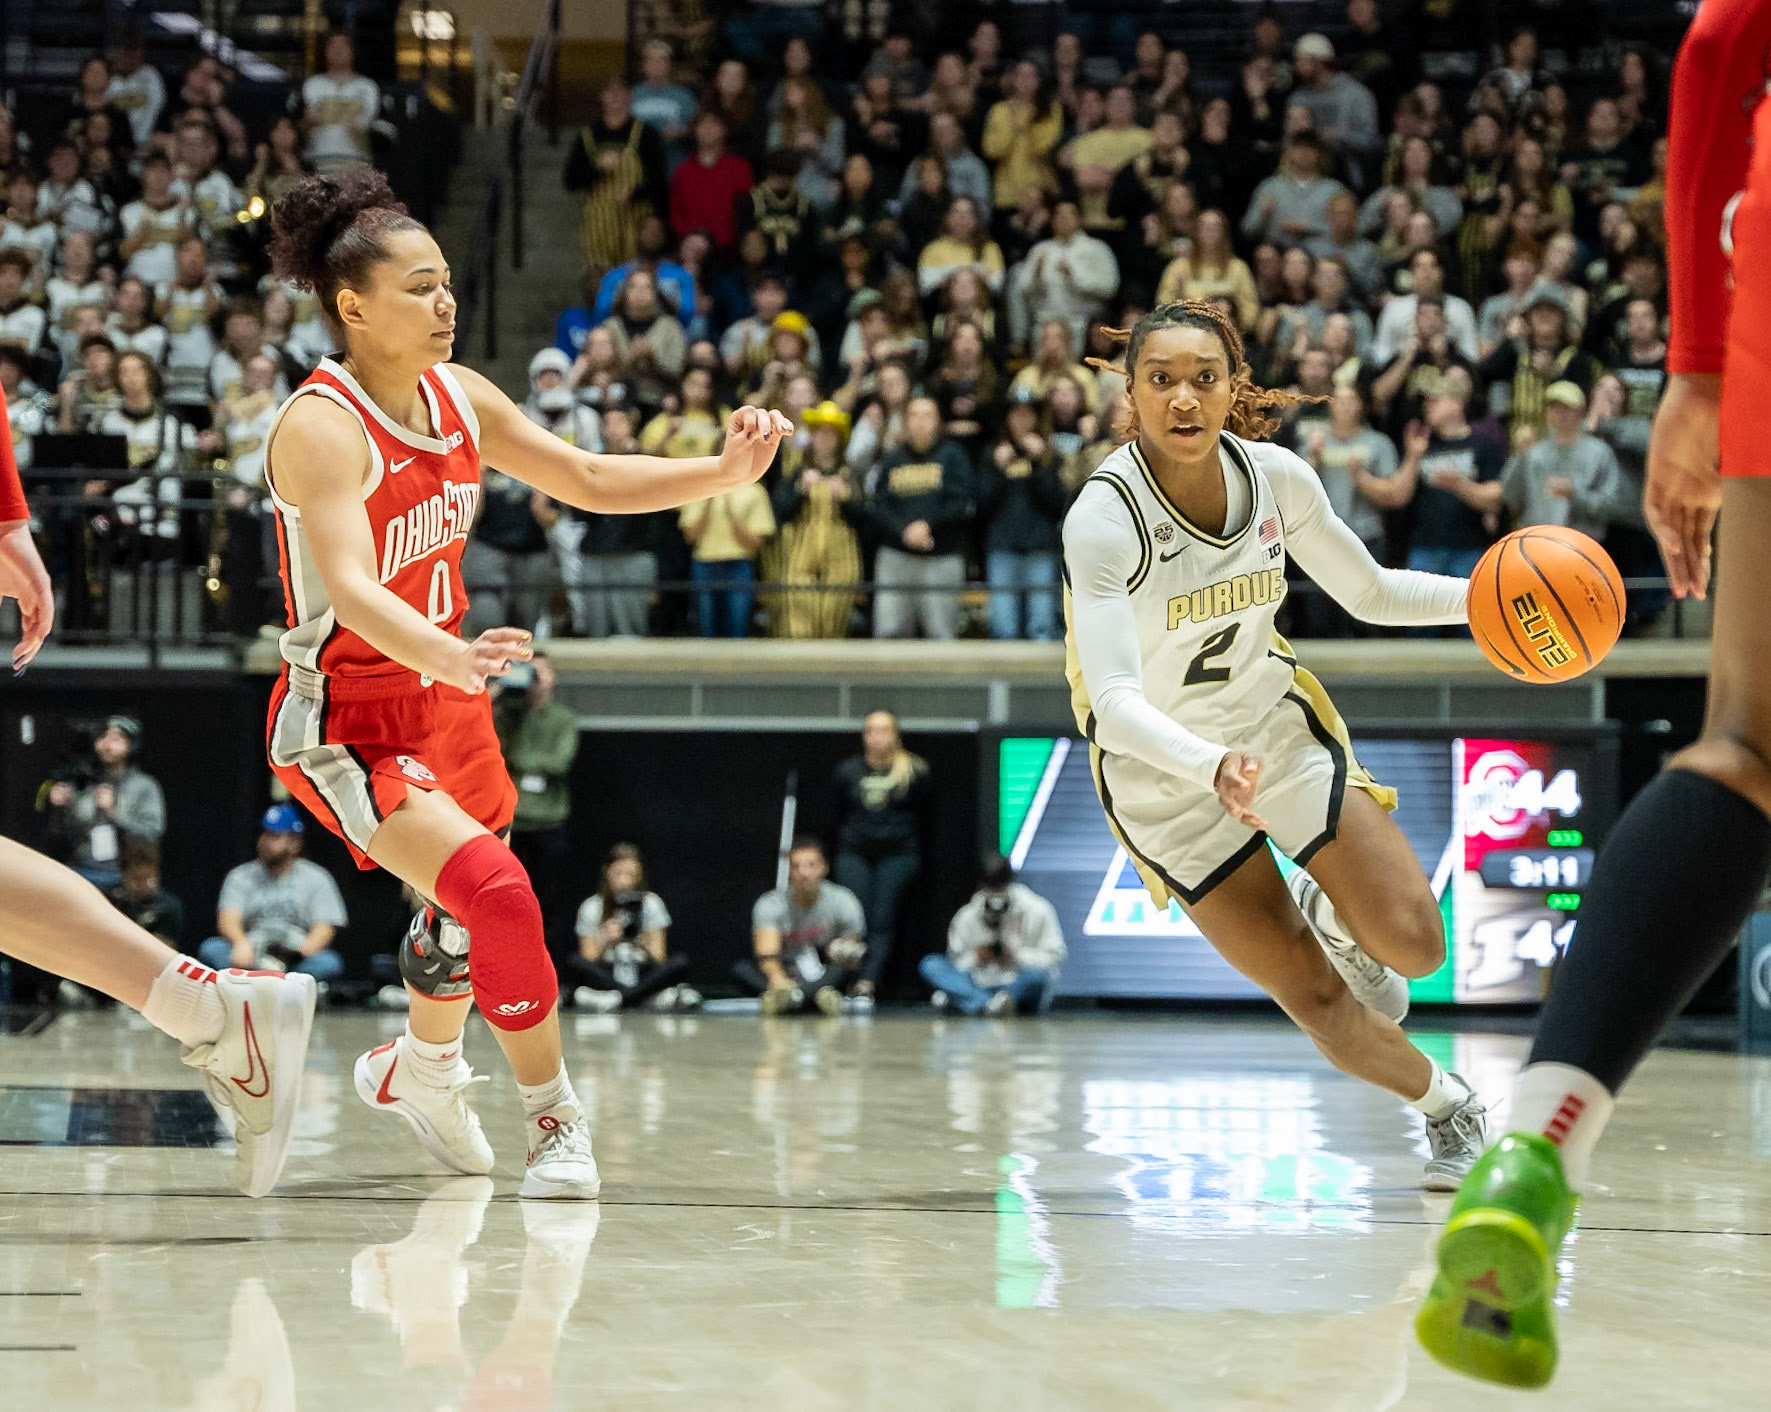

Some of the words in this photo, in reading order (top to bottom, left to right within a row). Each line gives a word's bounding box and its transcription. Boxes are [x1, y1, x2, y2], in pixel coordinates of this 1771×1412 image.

[428, 559, 453, 625] 0
[1167, 568, 1282, 631] PURDUE
[1182, 622, 1241, 687] 2
[1512, 591, 1572, 669] ELITE
[1541, 604, 1577, 660] CHAMPIONS
[1507, 768, 1582, 817] 44
[1509, 855, 1579, 888] 3:11
